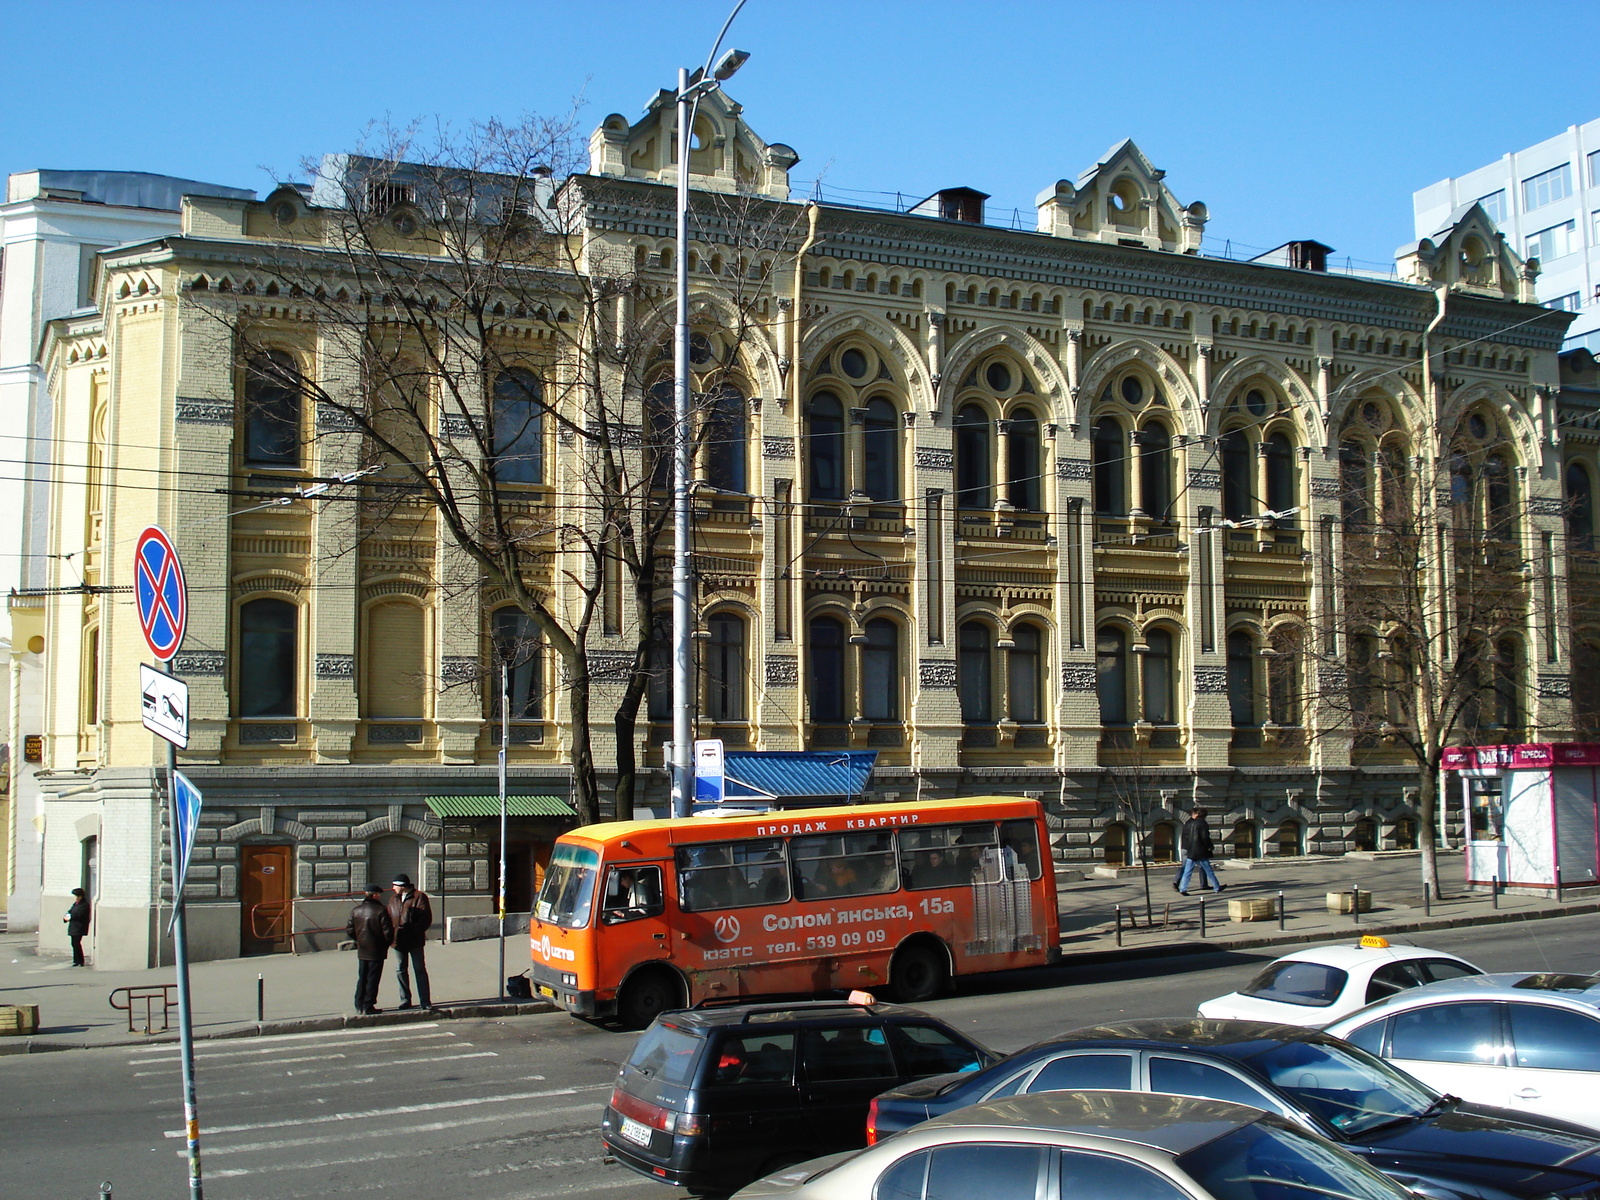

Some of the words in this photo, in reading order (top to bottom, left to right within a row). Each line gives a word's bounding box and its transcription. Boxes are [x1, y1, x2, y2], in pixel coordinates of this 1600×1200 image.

[757, 821, 827, 836] ПРОДАЖ
[847, 814, 920, 829] КВАРТИР
[919, 897, 955, 915] 15а
[766, 942, 801, 955] тел.
[806, 934, 837, 950] 539
[841, 931, 861, 947] 09
[866, 929, 886, 944] 09
